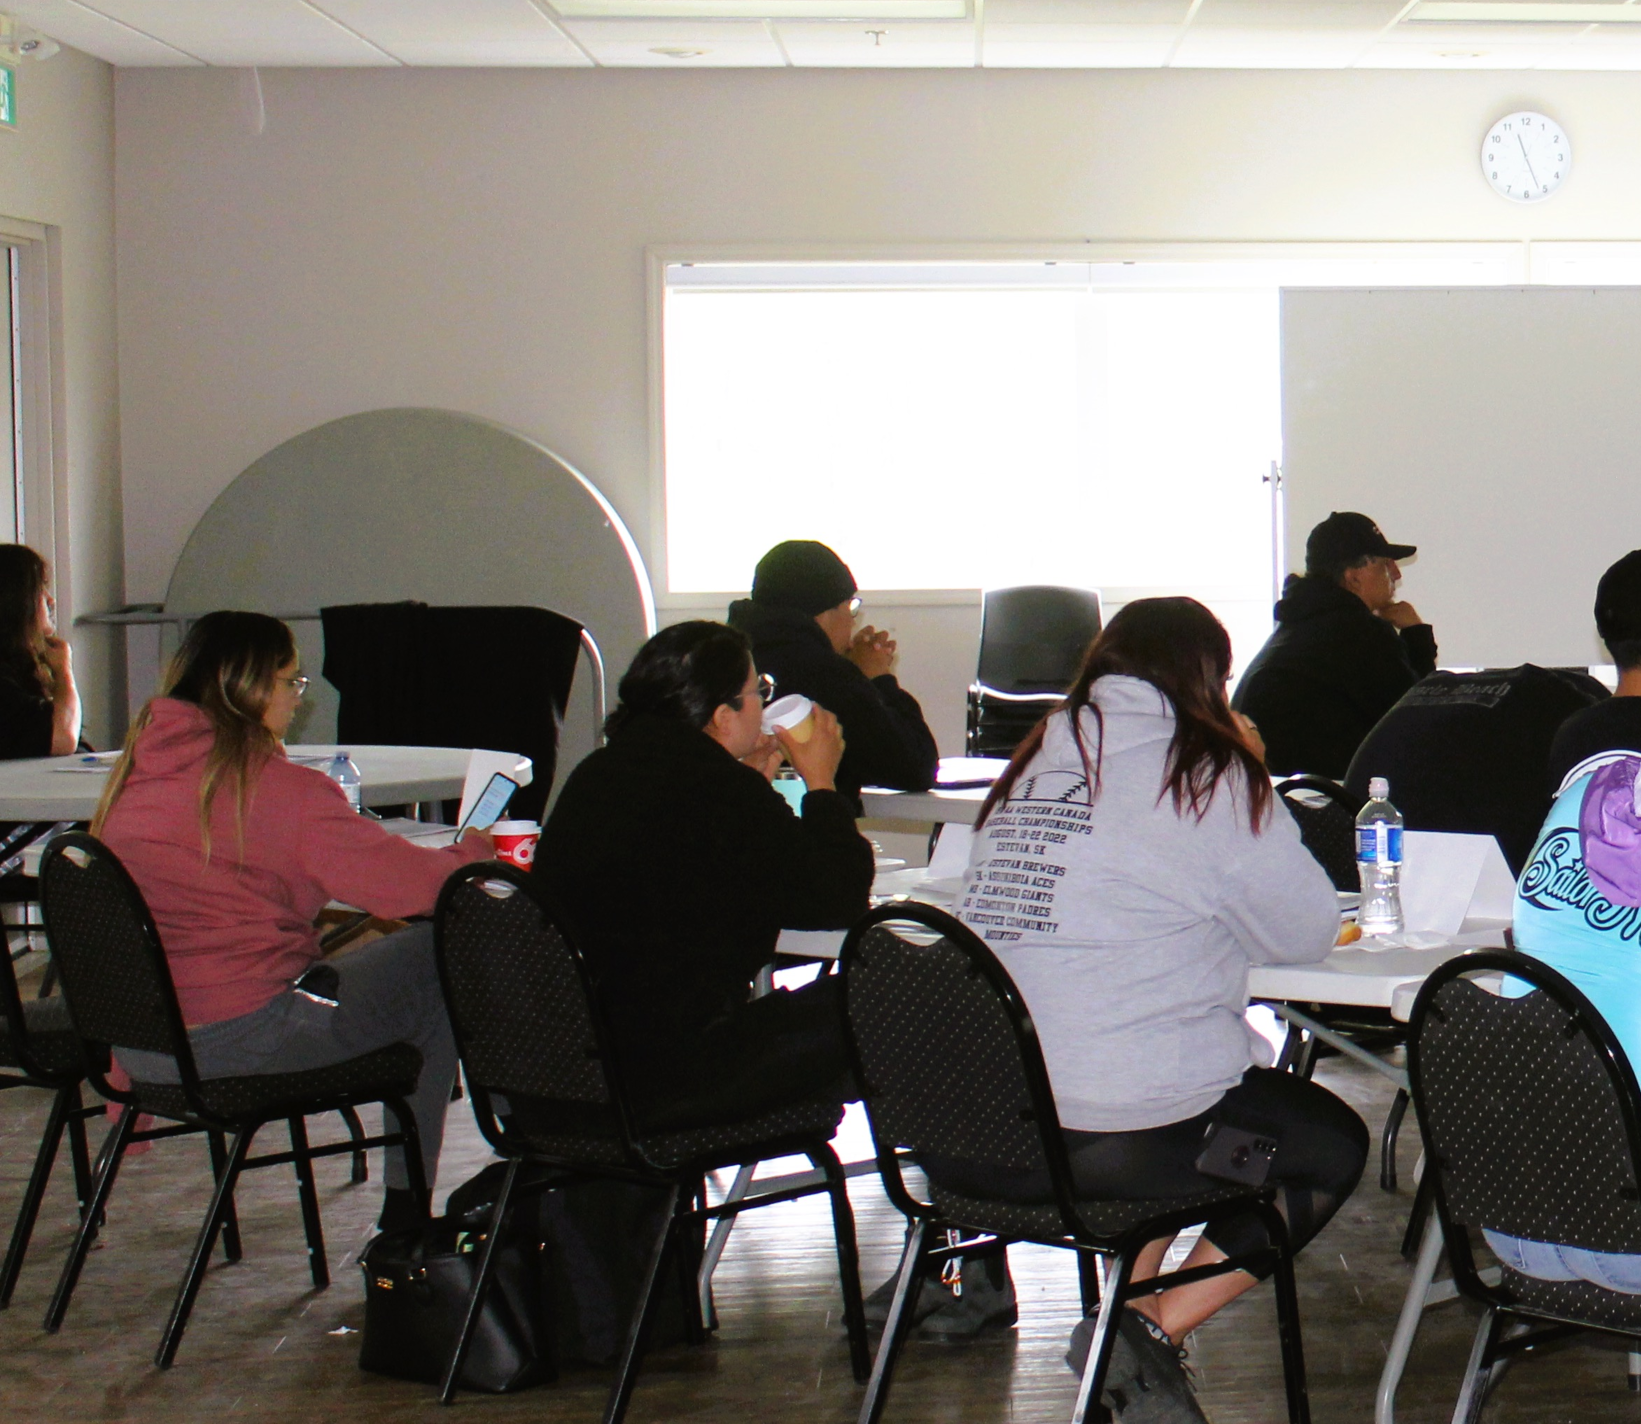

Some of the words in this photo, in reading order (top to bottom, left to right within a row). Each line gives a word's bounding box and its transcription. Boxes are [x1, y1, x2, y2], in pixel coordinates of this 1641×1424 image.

[1521, 118, 1531, 126] 12
[1503, 123, 1512, 131] 11
[1541, 123, 1545, 131] 1
[1491, 135, 1501, 143] 10
[1553, 135, 1559, 143] 2
[1488, 153, 1494, 162] 9
[1557, 153, 1563, 162] 3
[1492, 171, 1498, 180] 8
[1554, 171, 1560, 180] 4
[1506, 185, 1512, 193] 7
[1542, 185, 1548, 194] 5
[1523, 190, 1530, 199] 6
[1015, 806, 1053, 815] WESTERN
[1053, 807, 1092, 821] CANADA
[1018, 817, 1094, 835] CHAMPIONSHIPS
[1042, 831, 1067, 844] 2022
[1033, 844, 1047, 855] SK
[1022, 860, 1067, 877] BREWERS
[1518, 836, 1600, 910] Sailor
[1031, 876, 1056, 889] ACES
[982, 885, 1020, 899] ELMWOOD
[1021, 889, 1055, 903] GIANTS
[1017, 903, 1052, 917] PADRES
[1006, 916, 1059, 933] COMMUNITY
